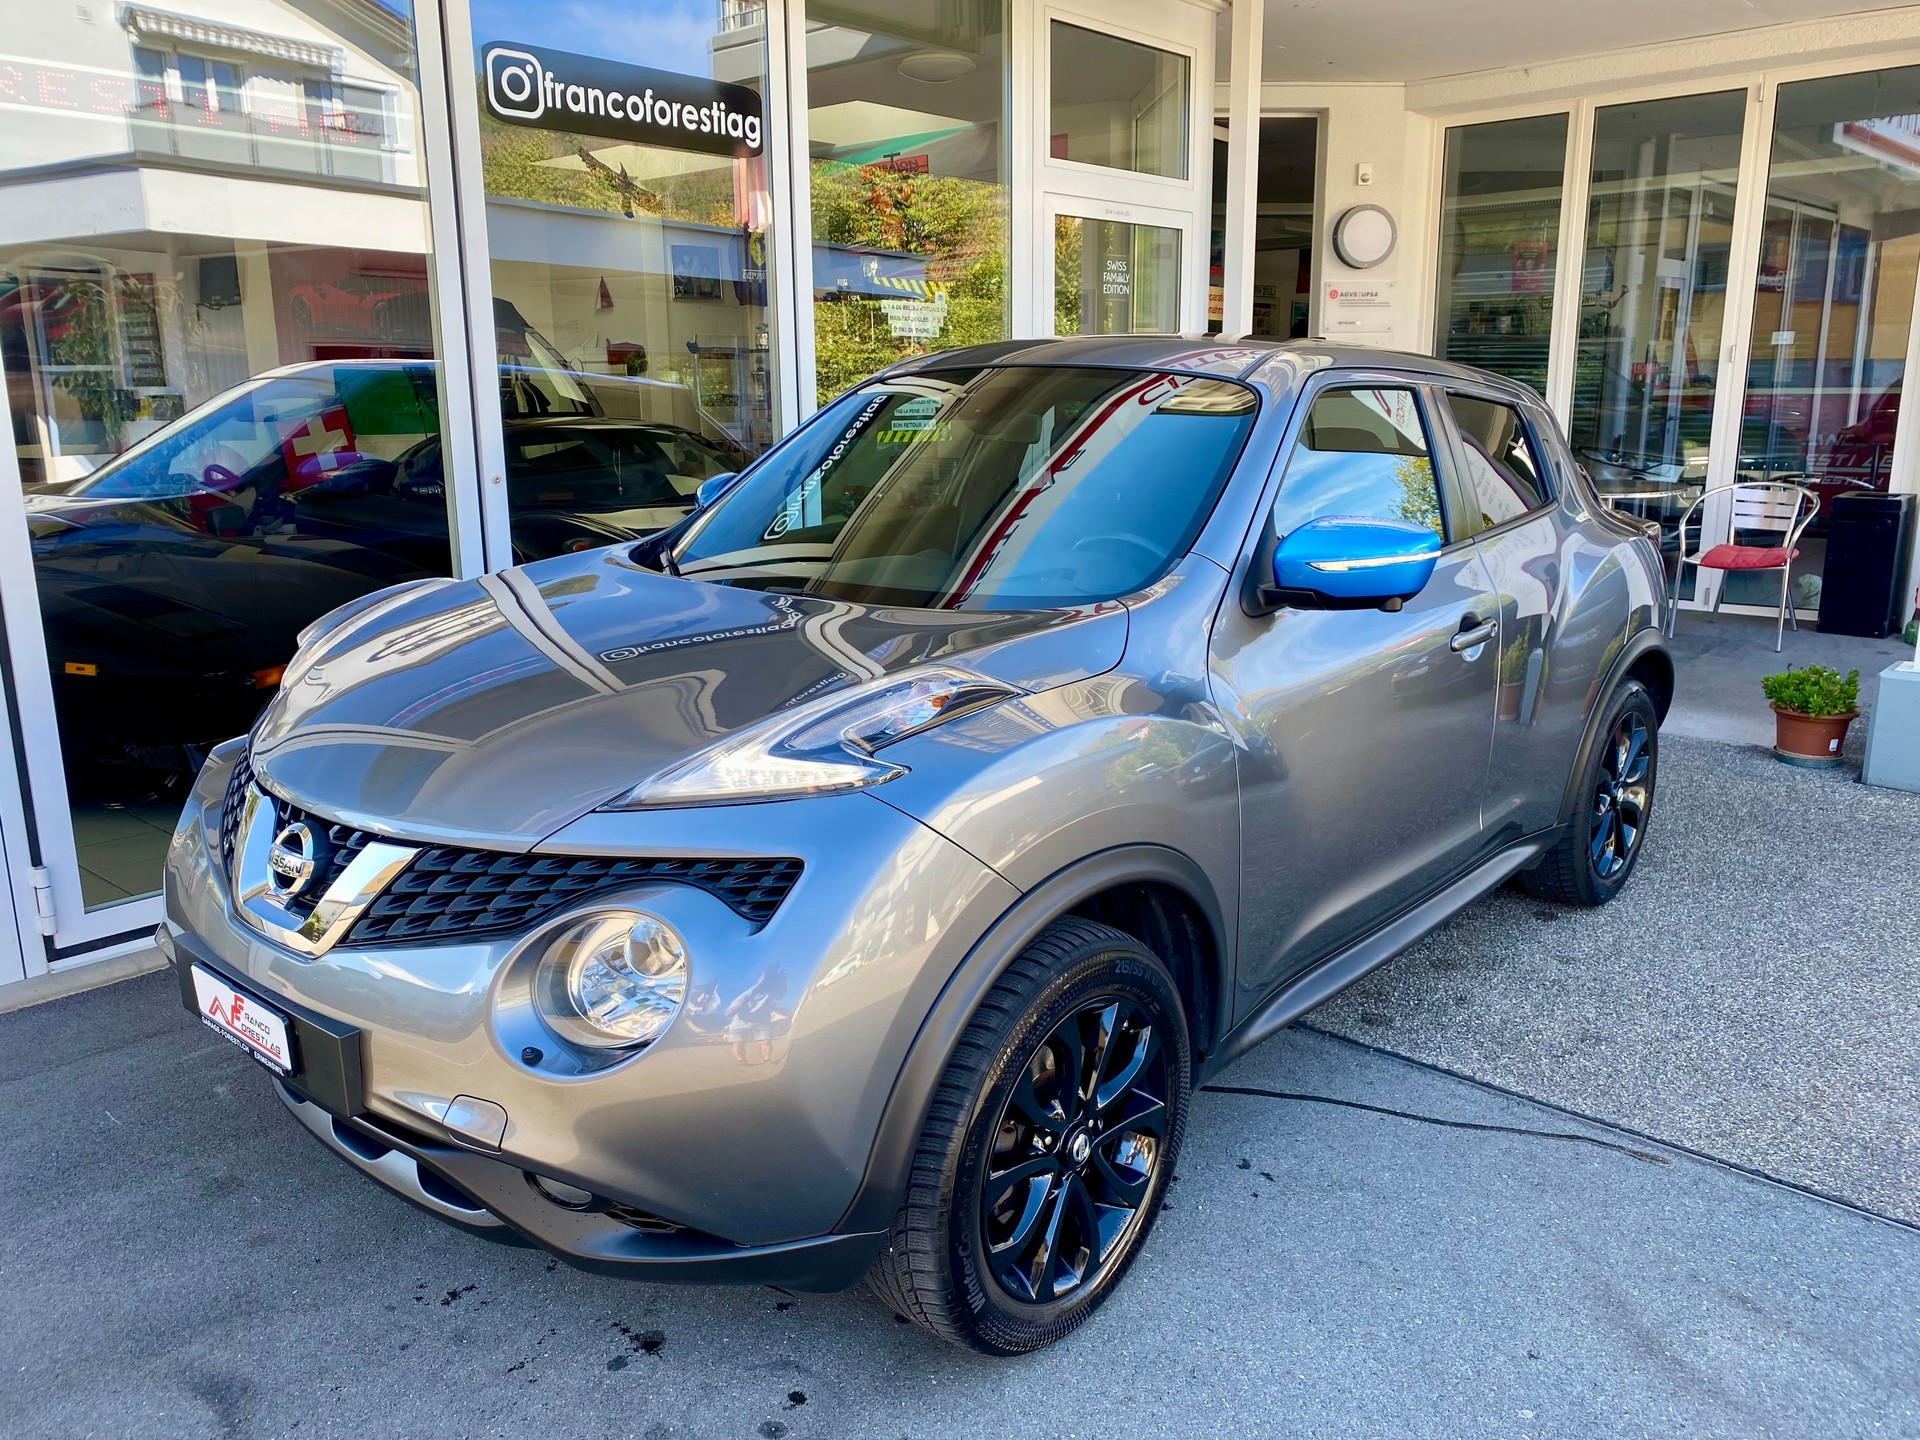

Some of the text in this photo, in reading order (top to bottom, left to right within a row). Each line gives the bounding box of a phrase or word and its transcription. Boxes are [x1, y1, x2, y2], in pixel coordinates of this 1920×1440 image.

[544, 71, 761, 148] francoforestiag
[1106, 260, 1127, 271] SWISS
[1103, 283, 1130, 295] EDITION
